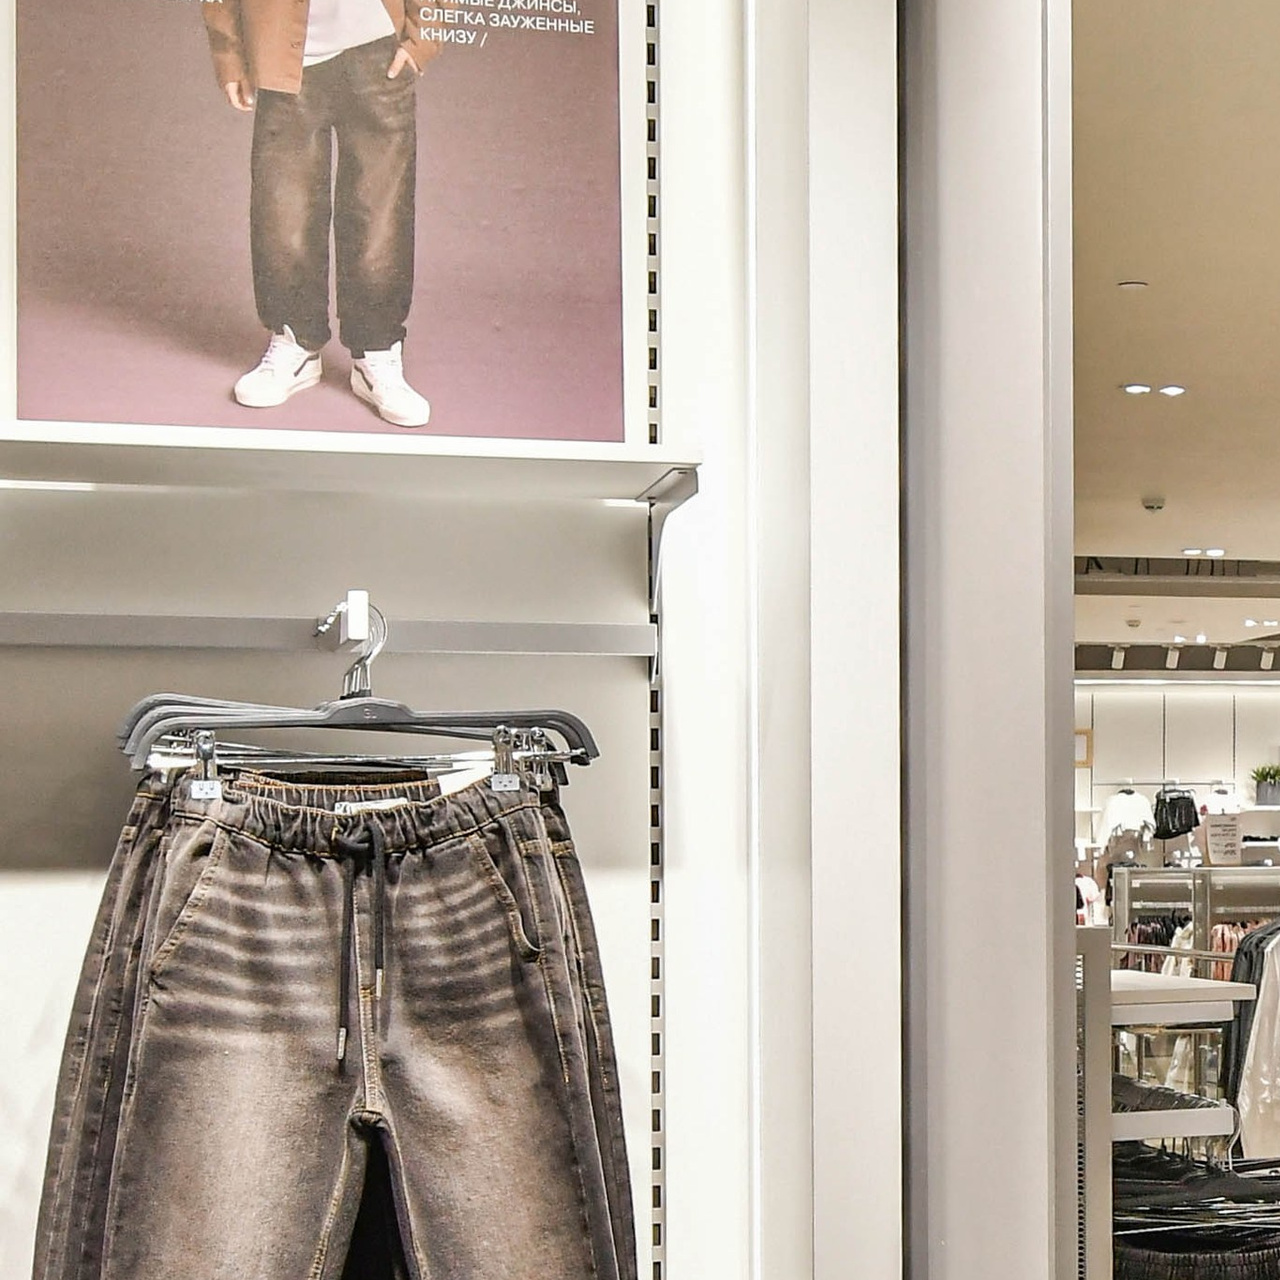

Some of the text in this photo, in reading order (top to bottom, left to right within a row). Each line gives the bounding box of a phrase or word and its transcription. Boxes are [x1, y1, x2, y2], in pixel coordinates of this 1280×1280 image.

[419, 7, 595, 35] СЛЕГКА ЗАУЖЕННЫЕ
[419, 27, 477, 46] КНИЗУ
